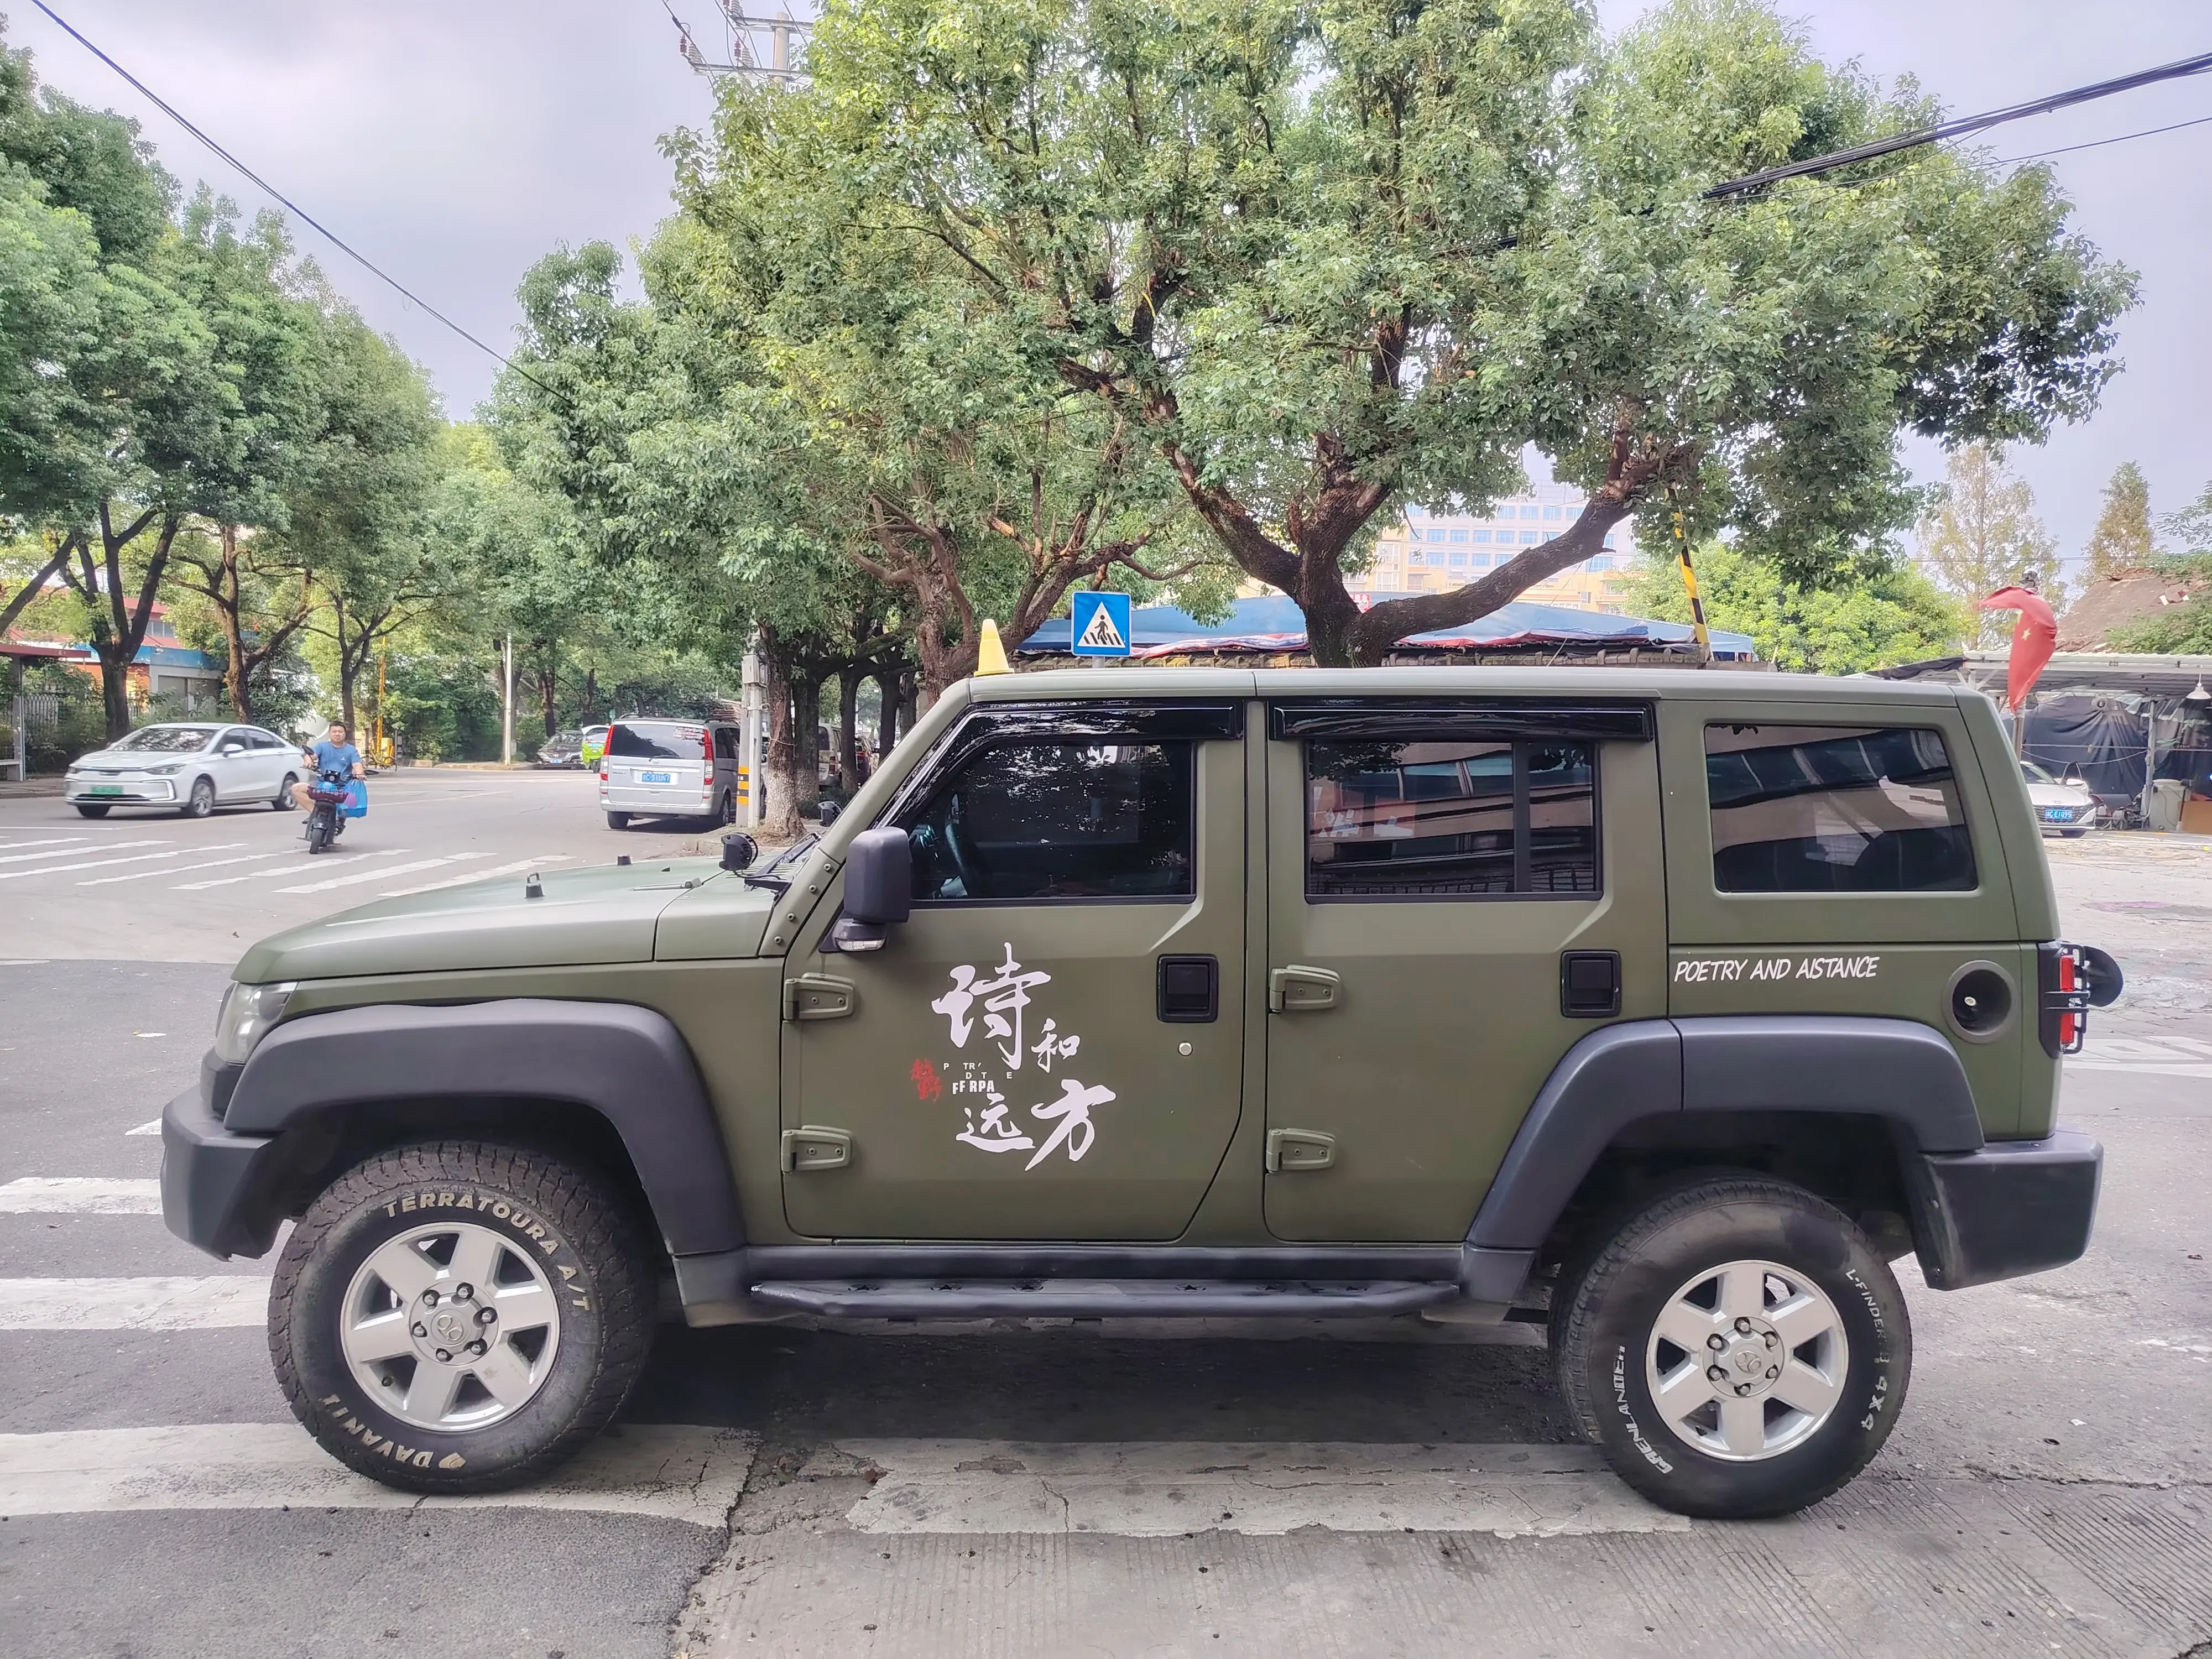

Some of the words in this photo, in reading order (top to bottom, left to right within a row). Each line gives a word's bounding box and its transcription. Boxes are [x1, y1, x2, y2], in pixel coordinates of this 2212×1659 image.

[1674, 958, 1749, 982] POETRY
[1749, 958, 1791, 980] AND
[1795, 956, 1880, 980] AISTANCE
[382, 1192, 559, 1255] TERRATOURA
[557, 1264, 591, 1311] A/T
